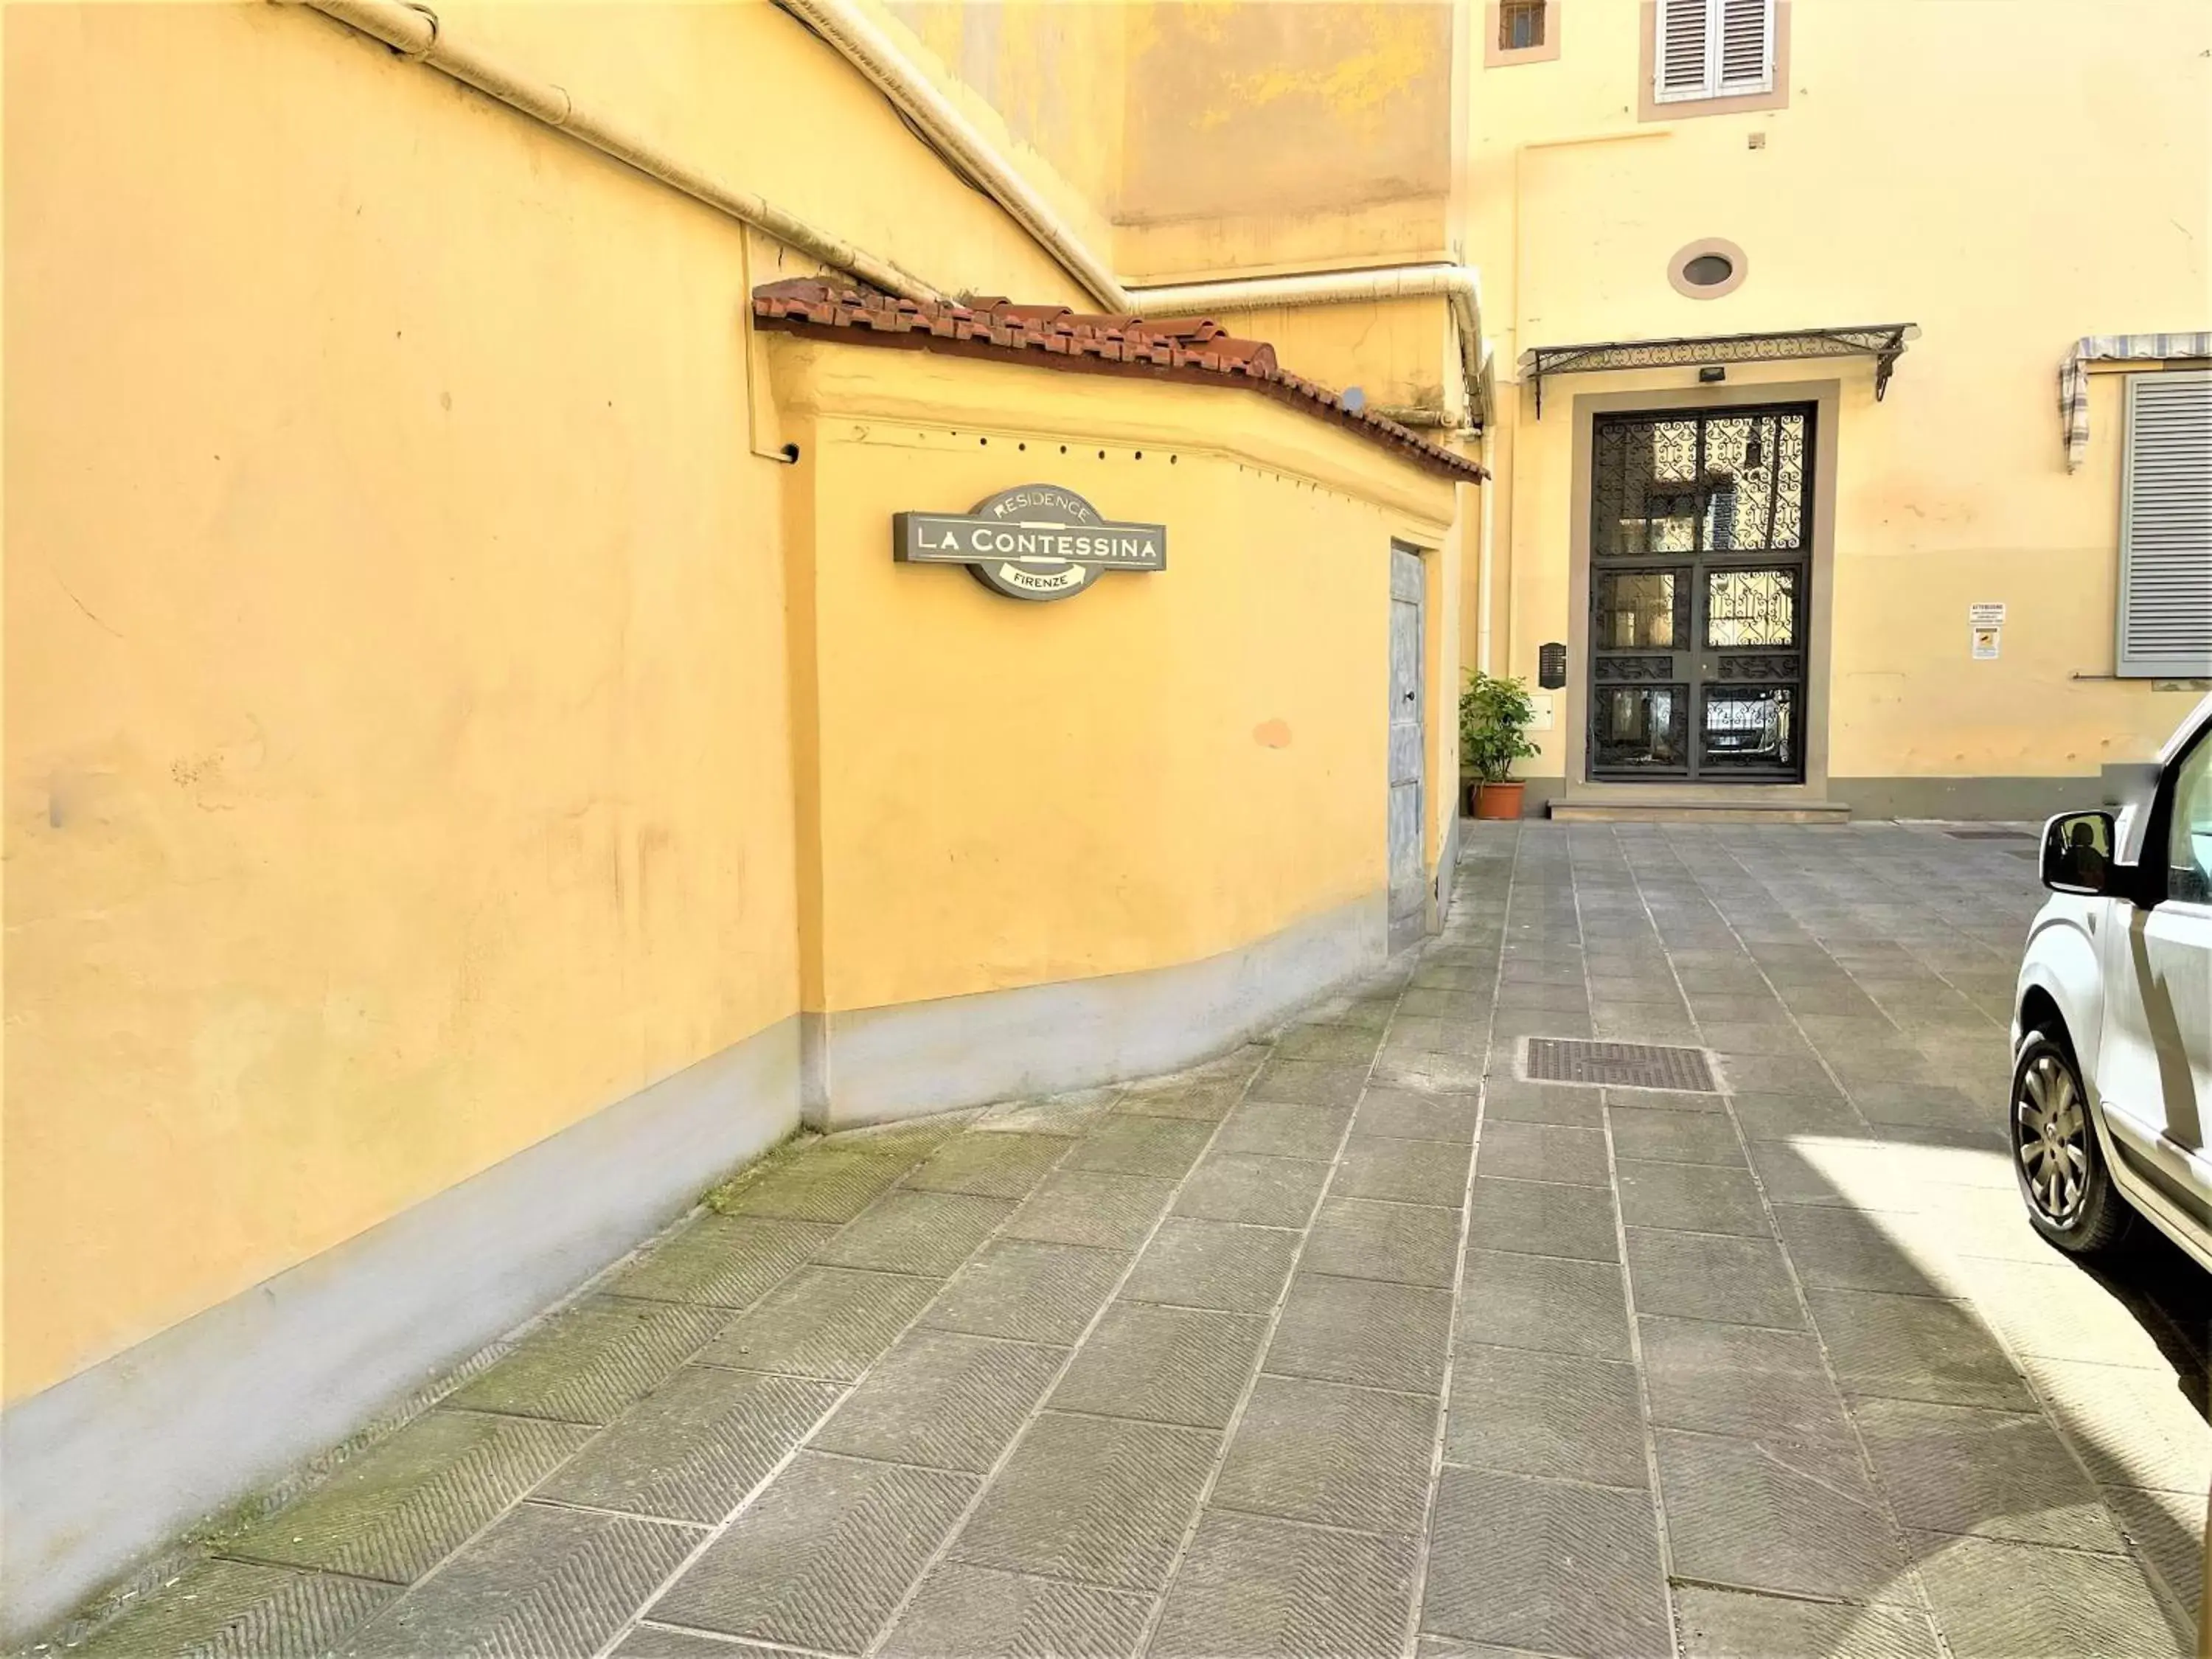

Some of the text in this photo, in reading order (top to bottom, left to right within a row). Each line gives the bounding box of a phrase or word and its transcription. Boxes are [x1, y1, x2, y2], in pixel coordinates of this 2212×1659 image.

[994, 492, 1090, 524] RESIDENCE
[918, 527, 1157, 557] LA CONTESSINA
[1014, 572, 1069, 588] FIRENZE
